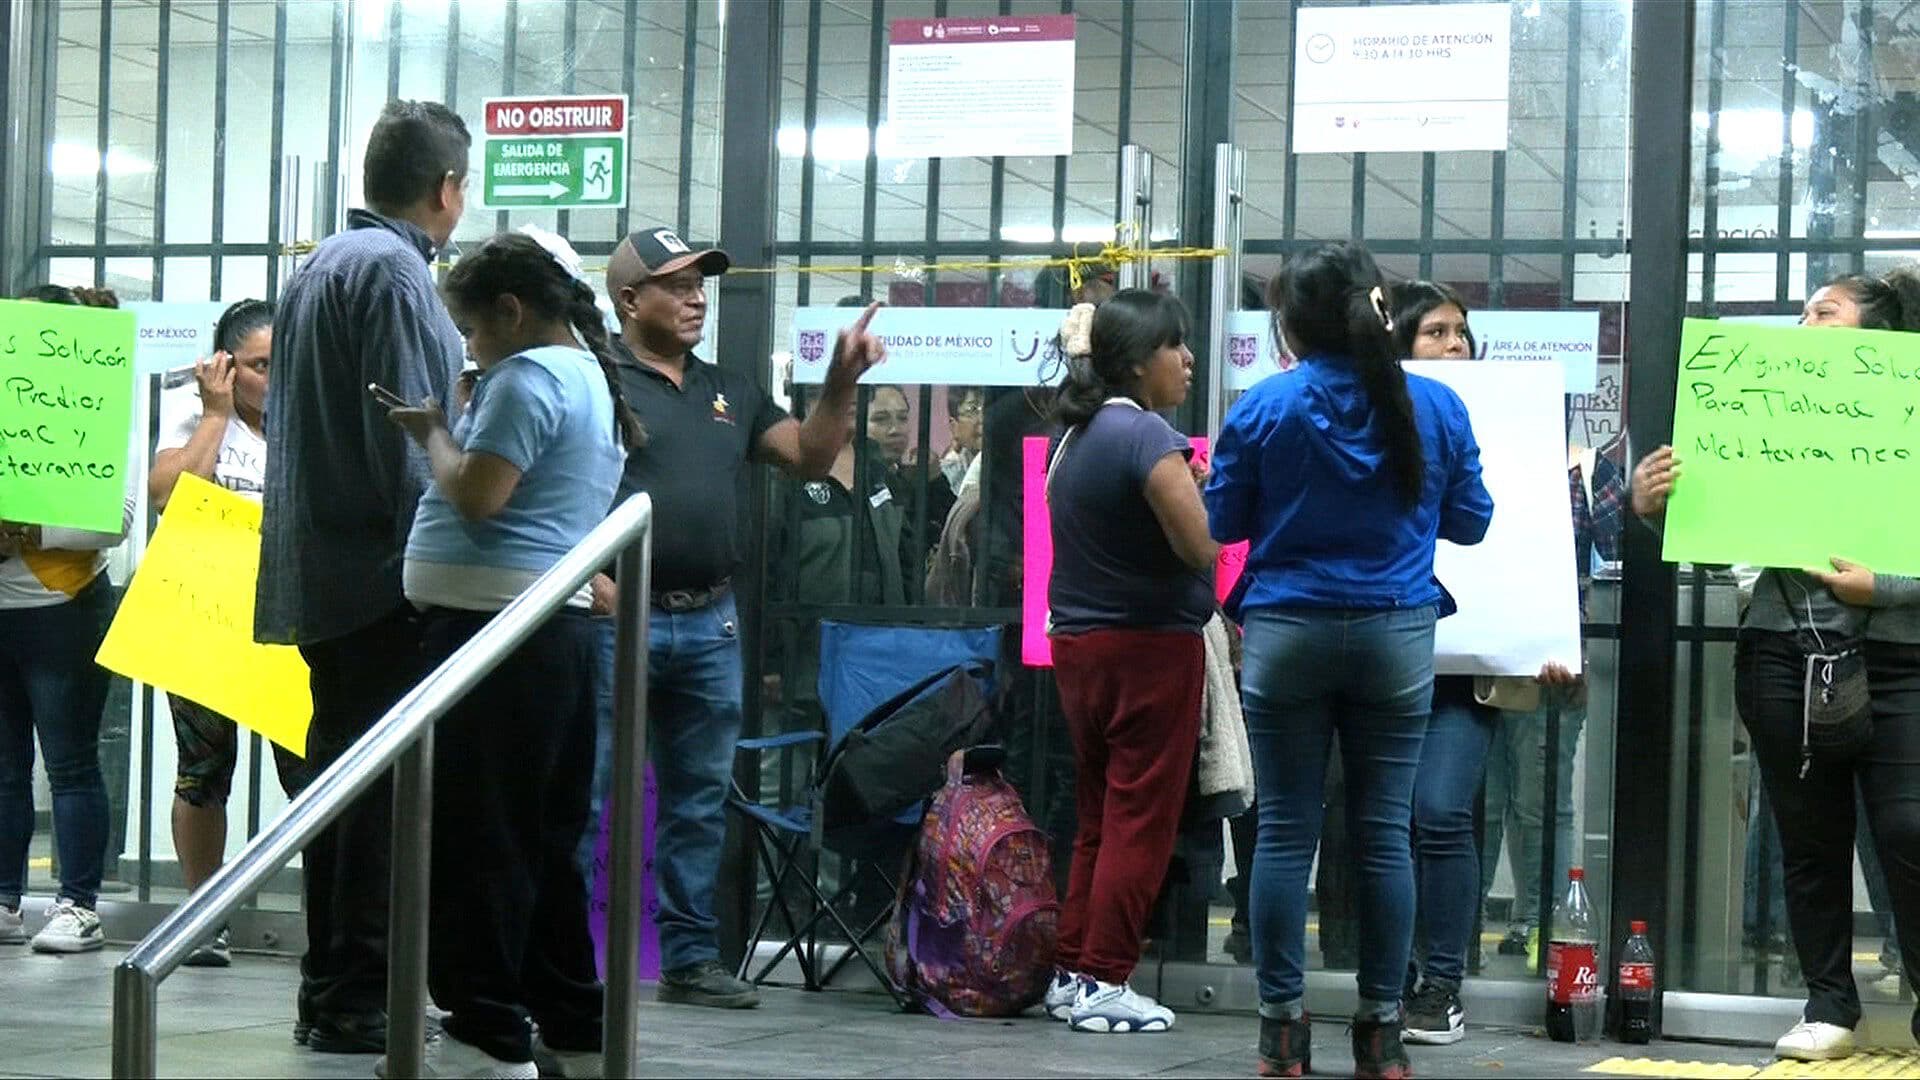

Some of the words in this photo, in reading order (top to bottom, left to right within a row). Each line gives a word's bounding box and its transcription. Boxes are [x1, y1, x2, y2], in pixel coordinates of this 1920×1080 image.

[1412, 35, 1428, 46] DE
[1432, 32, 1493, 45] ATENCIÓN
[496, 108, 525, 128] NO
[529, 106, 613, 127] OBSTRUIR
[501, 144, 544, 157] SALIDA
[547, 143, 563, 156] DE
[493, 162, 570, 177] EMERGENCIA
[140, 328, 154, 338] DE
[926, 336, 942, 347] DE
[946, 334, 993, 348] MÉXICO
[1493, 339, 1521, 352] ÁREA
[1523, 341, 1537, 352] DE
[6, 377, 104, 411] Predios
